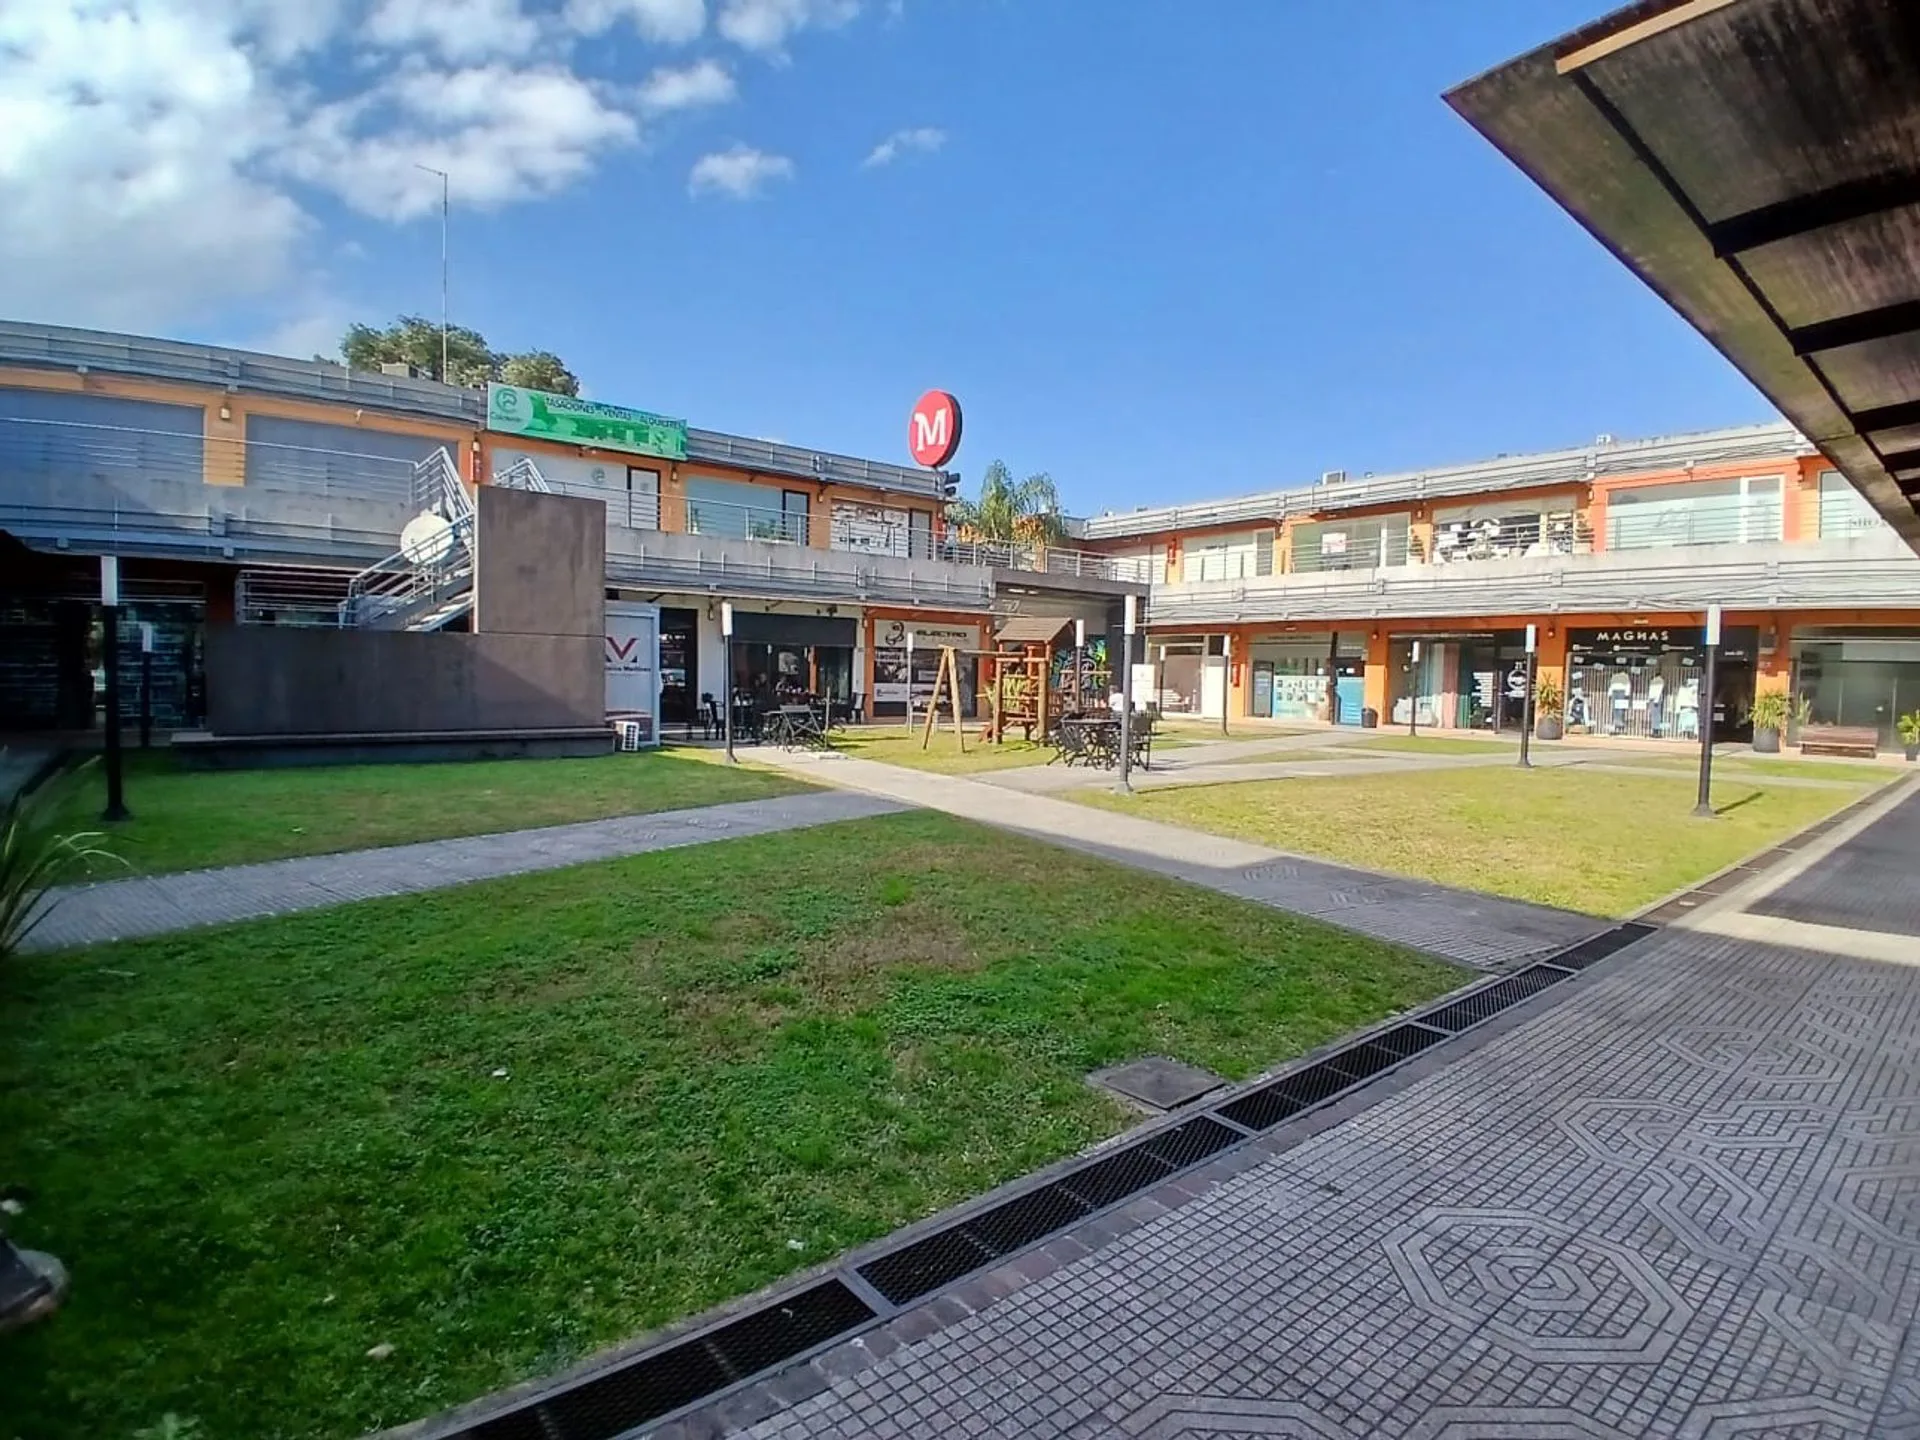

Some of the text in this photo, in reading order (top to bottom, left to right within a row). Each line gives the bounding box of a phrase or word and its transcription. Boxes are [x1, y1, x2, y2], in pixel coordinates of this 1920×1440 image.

[545, 396, 595, 414] TASACIONES
[603, 407, 632, 421] VENTAS
[914, 408, 947, 452] M
